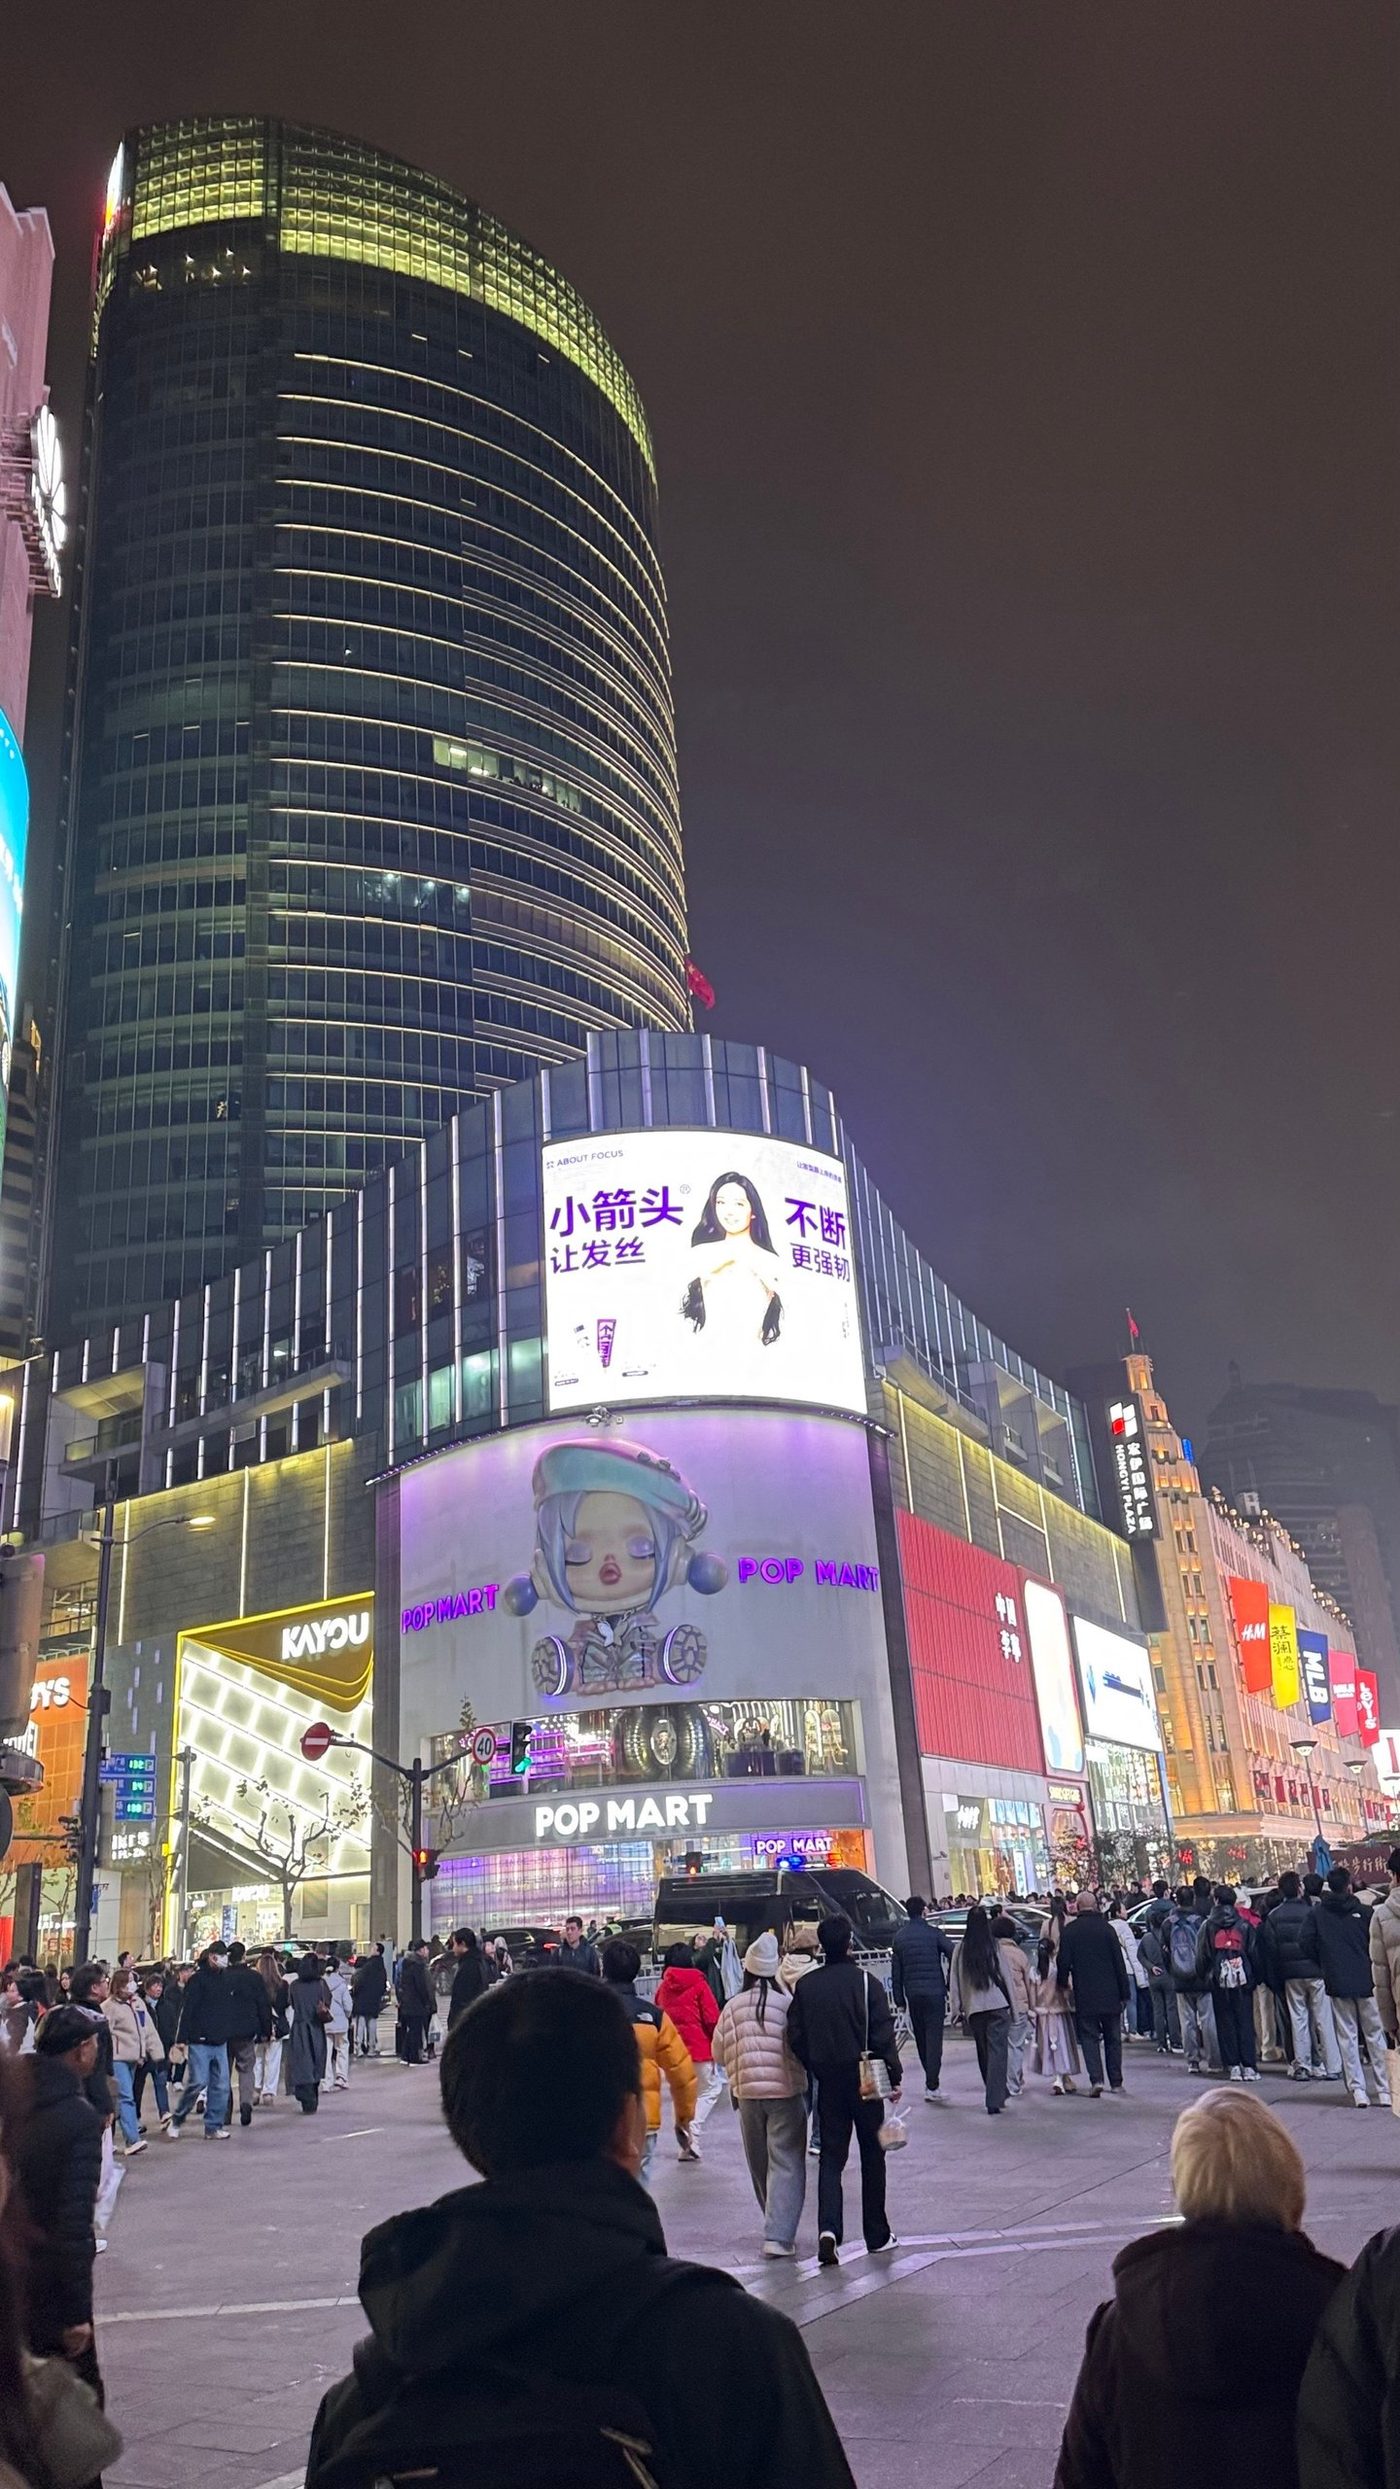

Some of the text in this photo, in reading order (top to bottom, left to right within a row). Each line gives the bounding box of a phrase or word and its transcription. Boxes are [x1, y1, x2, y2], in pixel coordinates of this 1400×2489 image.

[557, 1150, 624, 1167] ABOUT FOCUS
[550, 1186, 846, 1250] 小箭头 不断
[550, 1236, 850, 1282] 让发丝 更强韧
[1115, 1444, 1136, 1535] HONGYI PLAZA
[738, 1557, 879, 1592] POP MART
[401, 1584, 499, 1634] POP MART
[1241, 1622, 1266, 1640] H&M
[281, 1611, 370, 1660] KAYOU
[1302, 1650, 1329, 1705] MLB
[477, 1738, 492, 1754] 40
[536, 1794, 713, 1838] POP MART
[755, 1837, 834, 1855] POP MART
